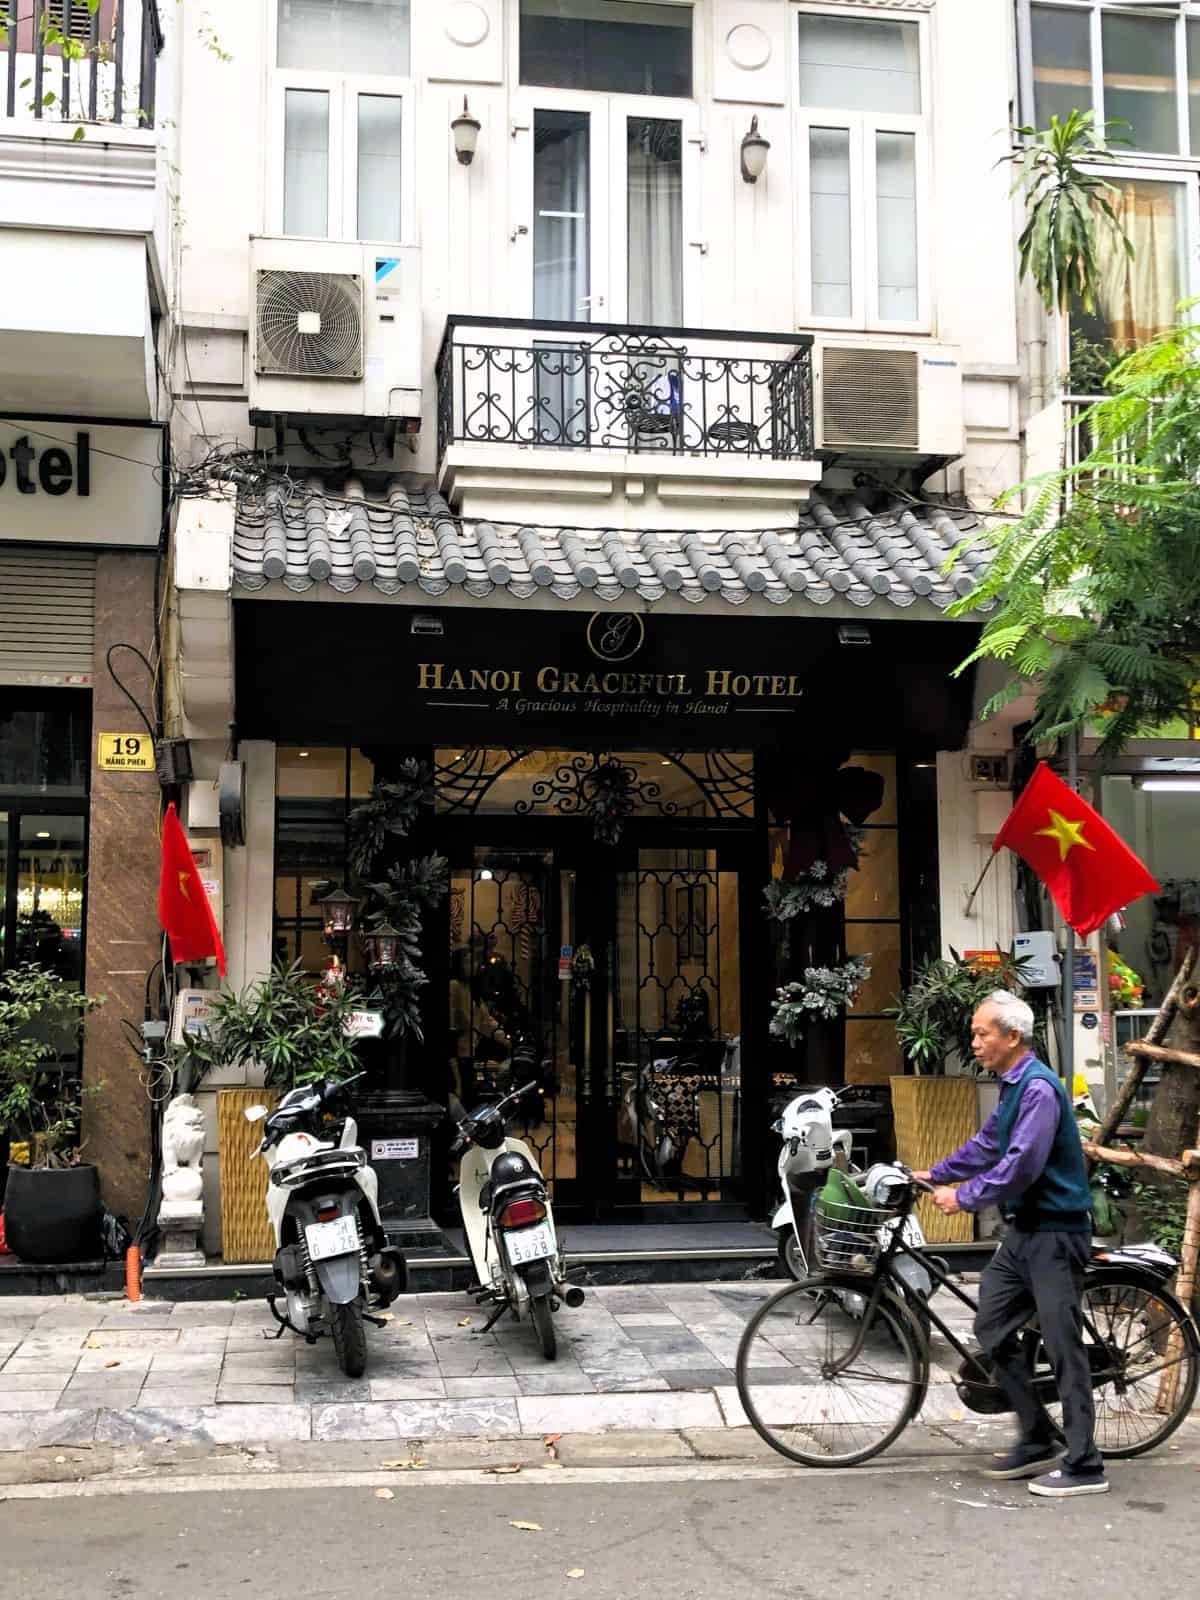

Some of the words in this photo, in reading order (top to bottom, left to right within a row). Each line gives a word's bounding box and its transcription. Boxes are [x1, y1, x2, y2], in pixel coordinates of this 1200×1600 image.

[0, 431, 90, 497] tel
[417, 663, 522, 692] HANOI
[536, 666, 692, 695] GRACEFUL
[704, 669, 803, 697] HOTEL
[496, 698, 509, 711] A
[515, 699, 577, 715] Gracious
[584, 699, 660, 717] Hospitality
[666, 701, 679, 714] in
[684, 702, 729, 715] Hanoi
[112, 737, 140, 756] 19
